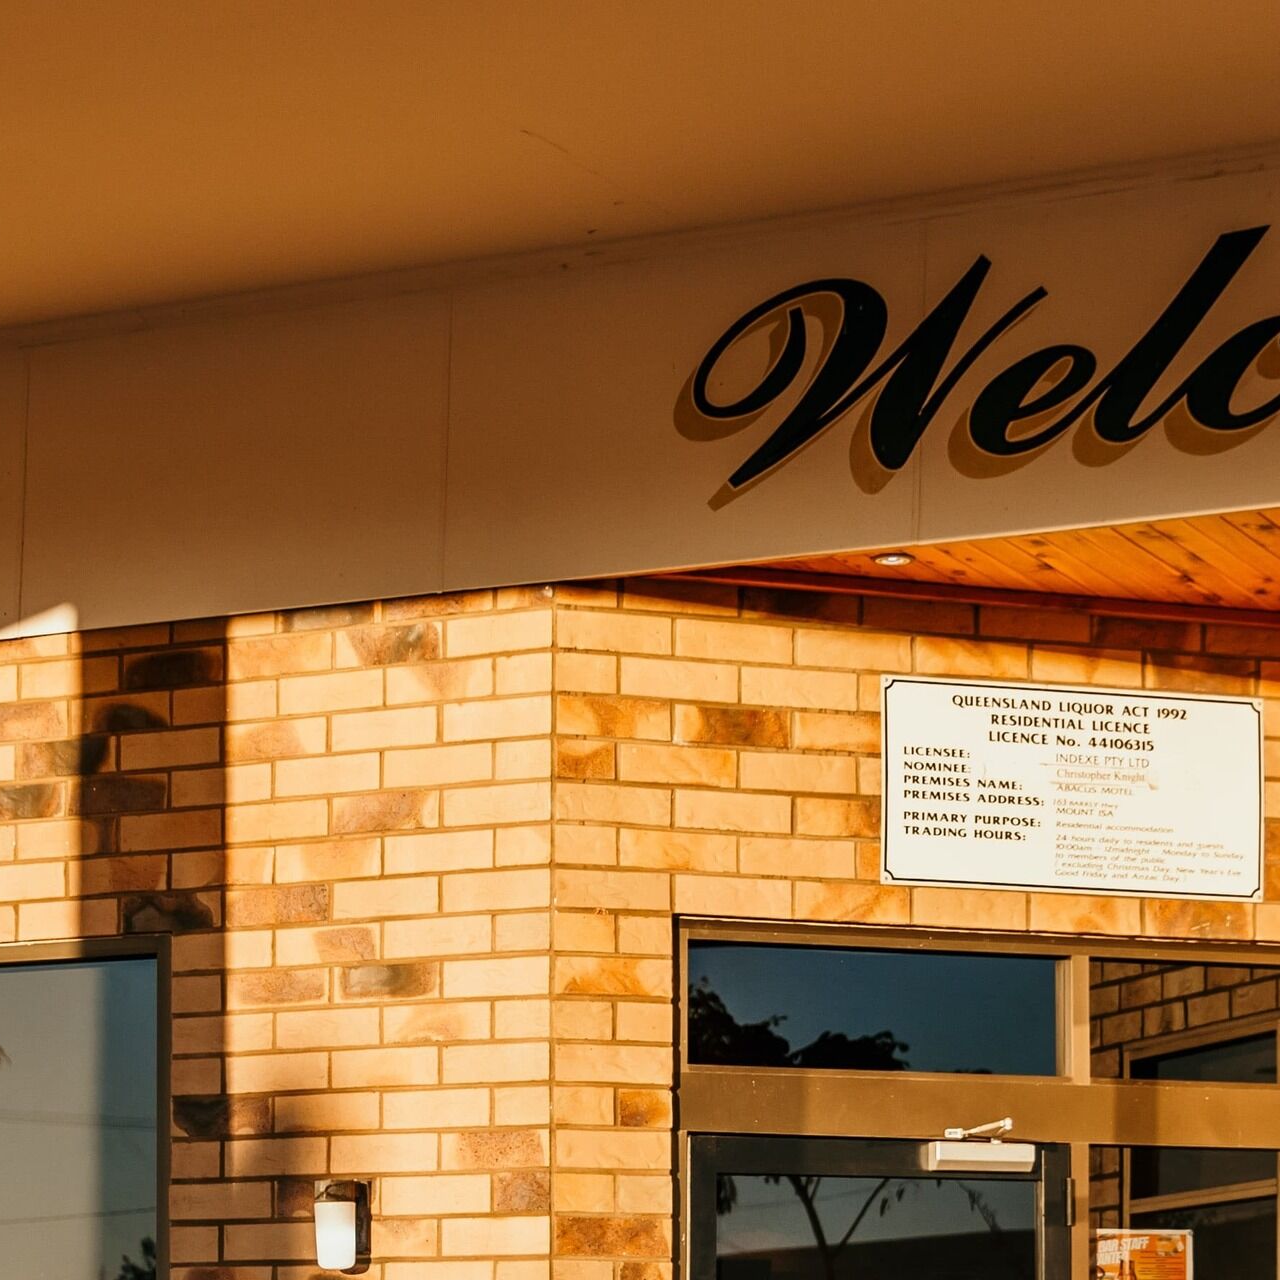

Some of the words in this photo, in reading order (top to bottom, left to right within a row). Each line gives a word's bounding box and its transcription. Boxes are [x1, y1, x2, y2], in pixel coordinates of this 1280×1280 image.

[952, 695, 1052, 711] QUEENSLAND
[1059, 702, 1114, 715] LIQUOR
[1122, 706, 1149, 717] ACT
[1157, 708, 1187, 720] 1992
[991, 714, 1084, 730] RESIDENTIAL
[1092, 720, 1150, 734] LICENCE
[989, 731, 1048, 745] LICENCE
[1056, 735, 1081, 747] No.
[1088, 737, 1154, 751] 44106315
[904, 746, 970, 758] LICENSEE:
[904, 761, 971, 773] NOMINEE:
[1105, 756, 1124, 767] PTY
[1129, 758, 1150, 769] LTD
[904, 775, 970, 787] PREMISES
[977, 779, 1023, 791] NAME:
[1056, 769, 1111, 781] Christopher
[1114, 771, 1145, 782] Knight
[904, 789, 970, 802] PREMISES
[977, 794, 1044, 806] ADDRESS:
[904, 811, 968, 823] PRIMARY
[975, 815, 1041, 827] PURPOSE:
[1056, 807, 1094, 816] MOUNT
[904, 825, 967, 838] TRADING
[974, 830, 1026, 841] HOURS:
